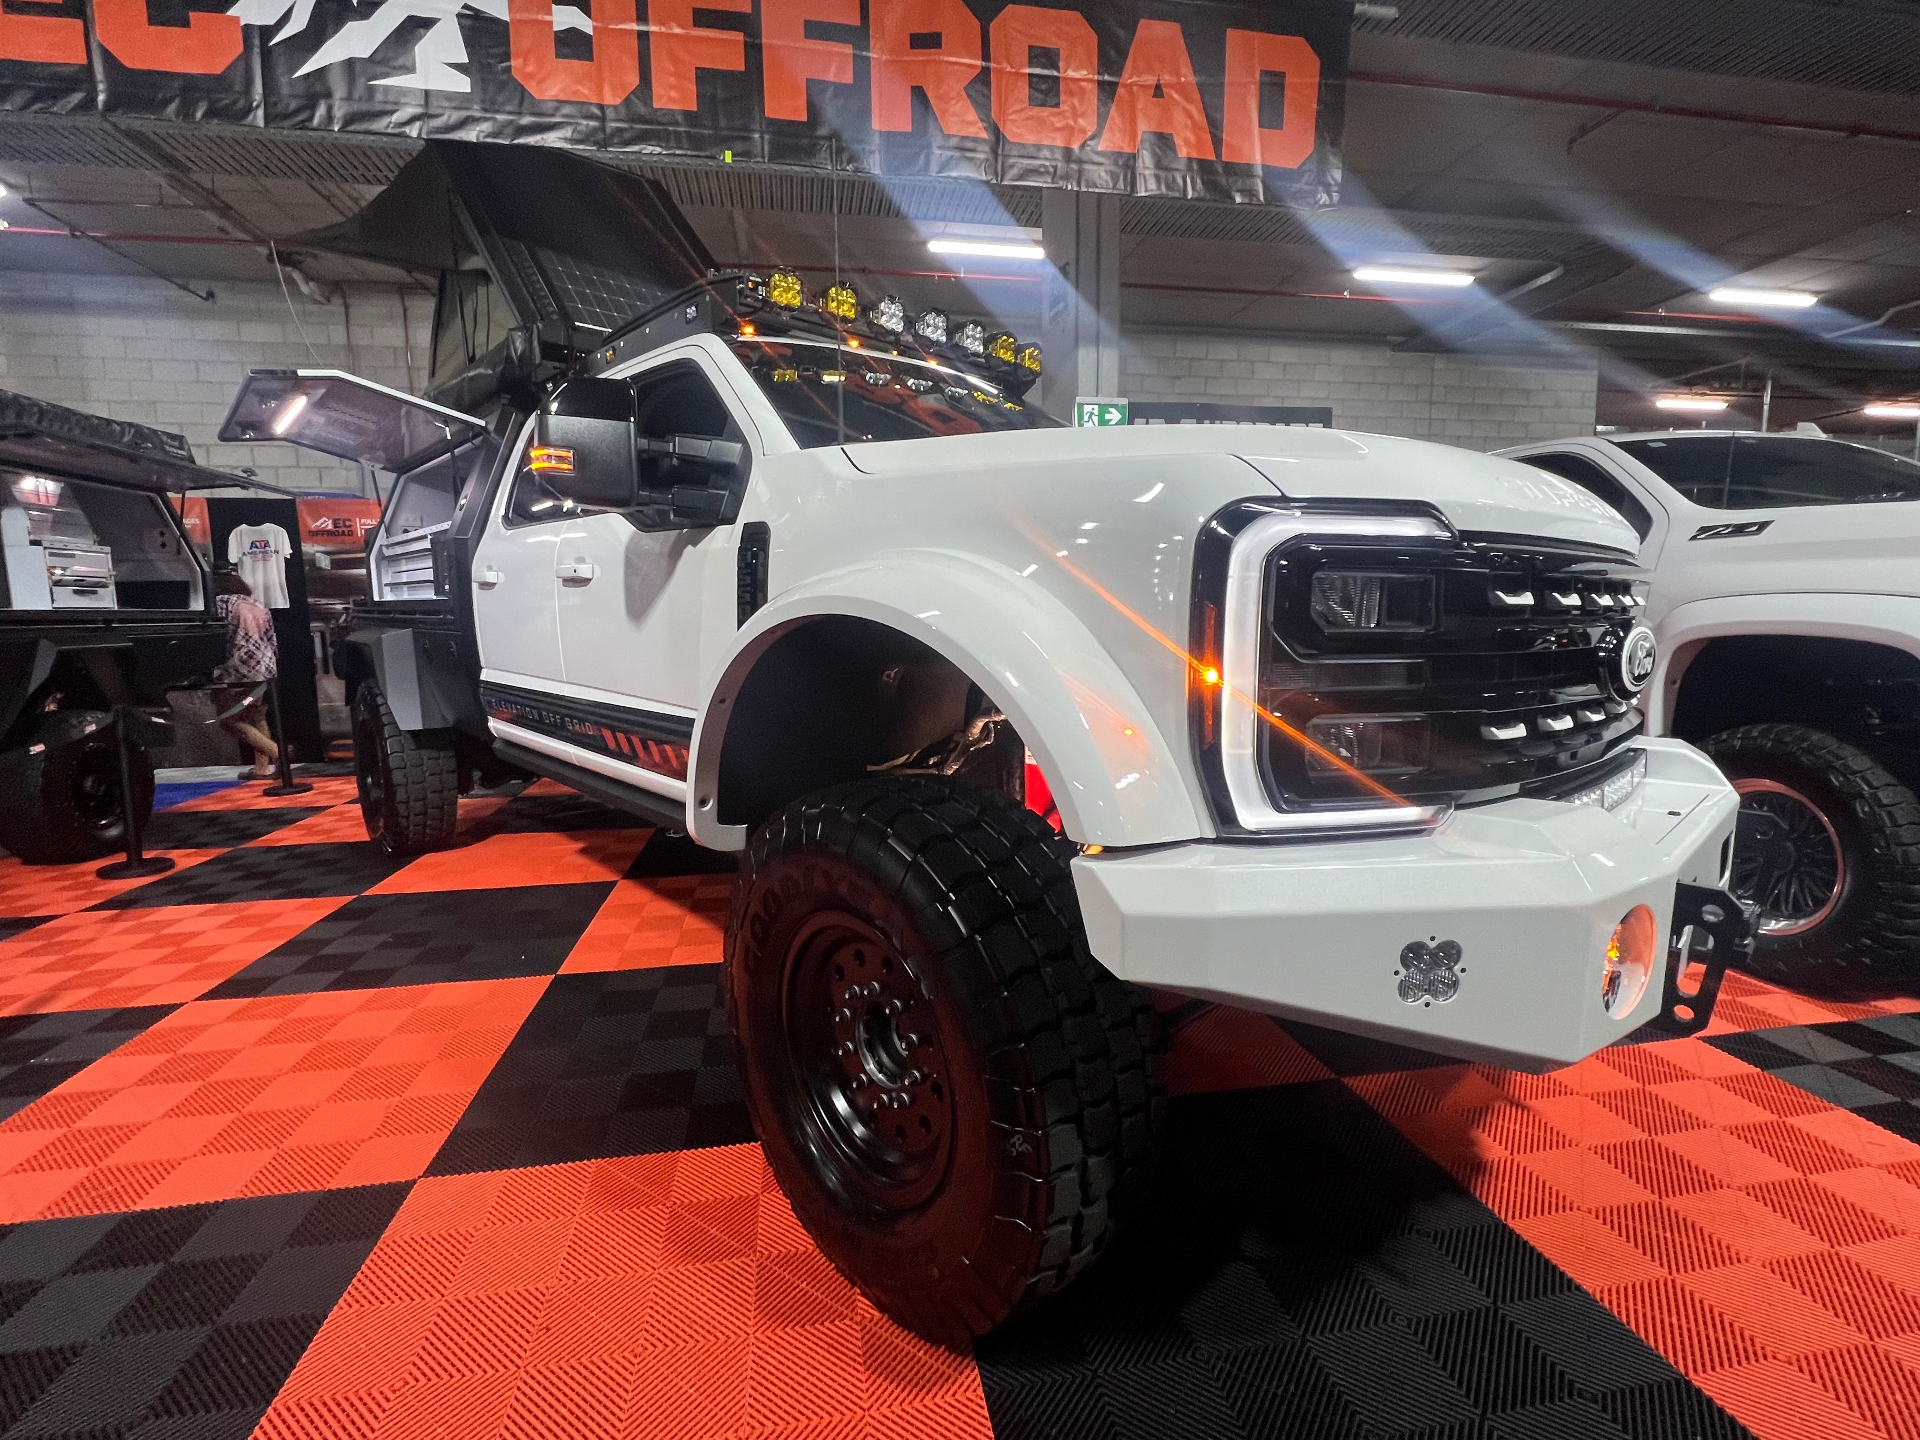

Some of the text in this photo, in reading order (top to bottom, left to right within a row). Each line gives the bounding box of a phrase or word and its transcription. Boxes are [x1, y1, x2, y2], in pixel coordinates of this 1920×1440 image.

[509, 0, 1321, 169] OFFROAD
[308, 529, 354, 537] OFFROAD
[242, 549, 280, 557] AMERICAN
[491, 698, 594, 735] ELEVATION OFF GRID
